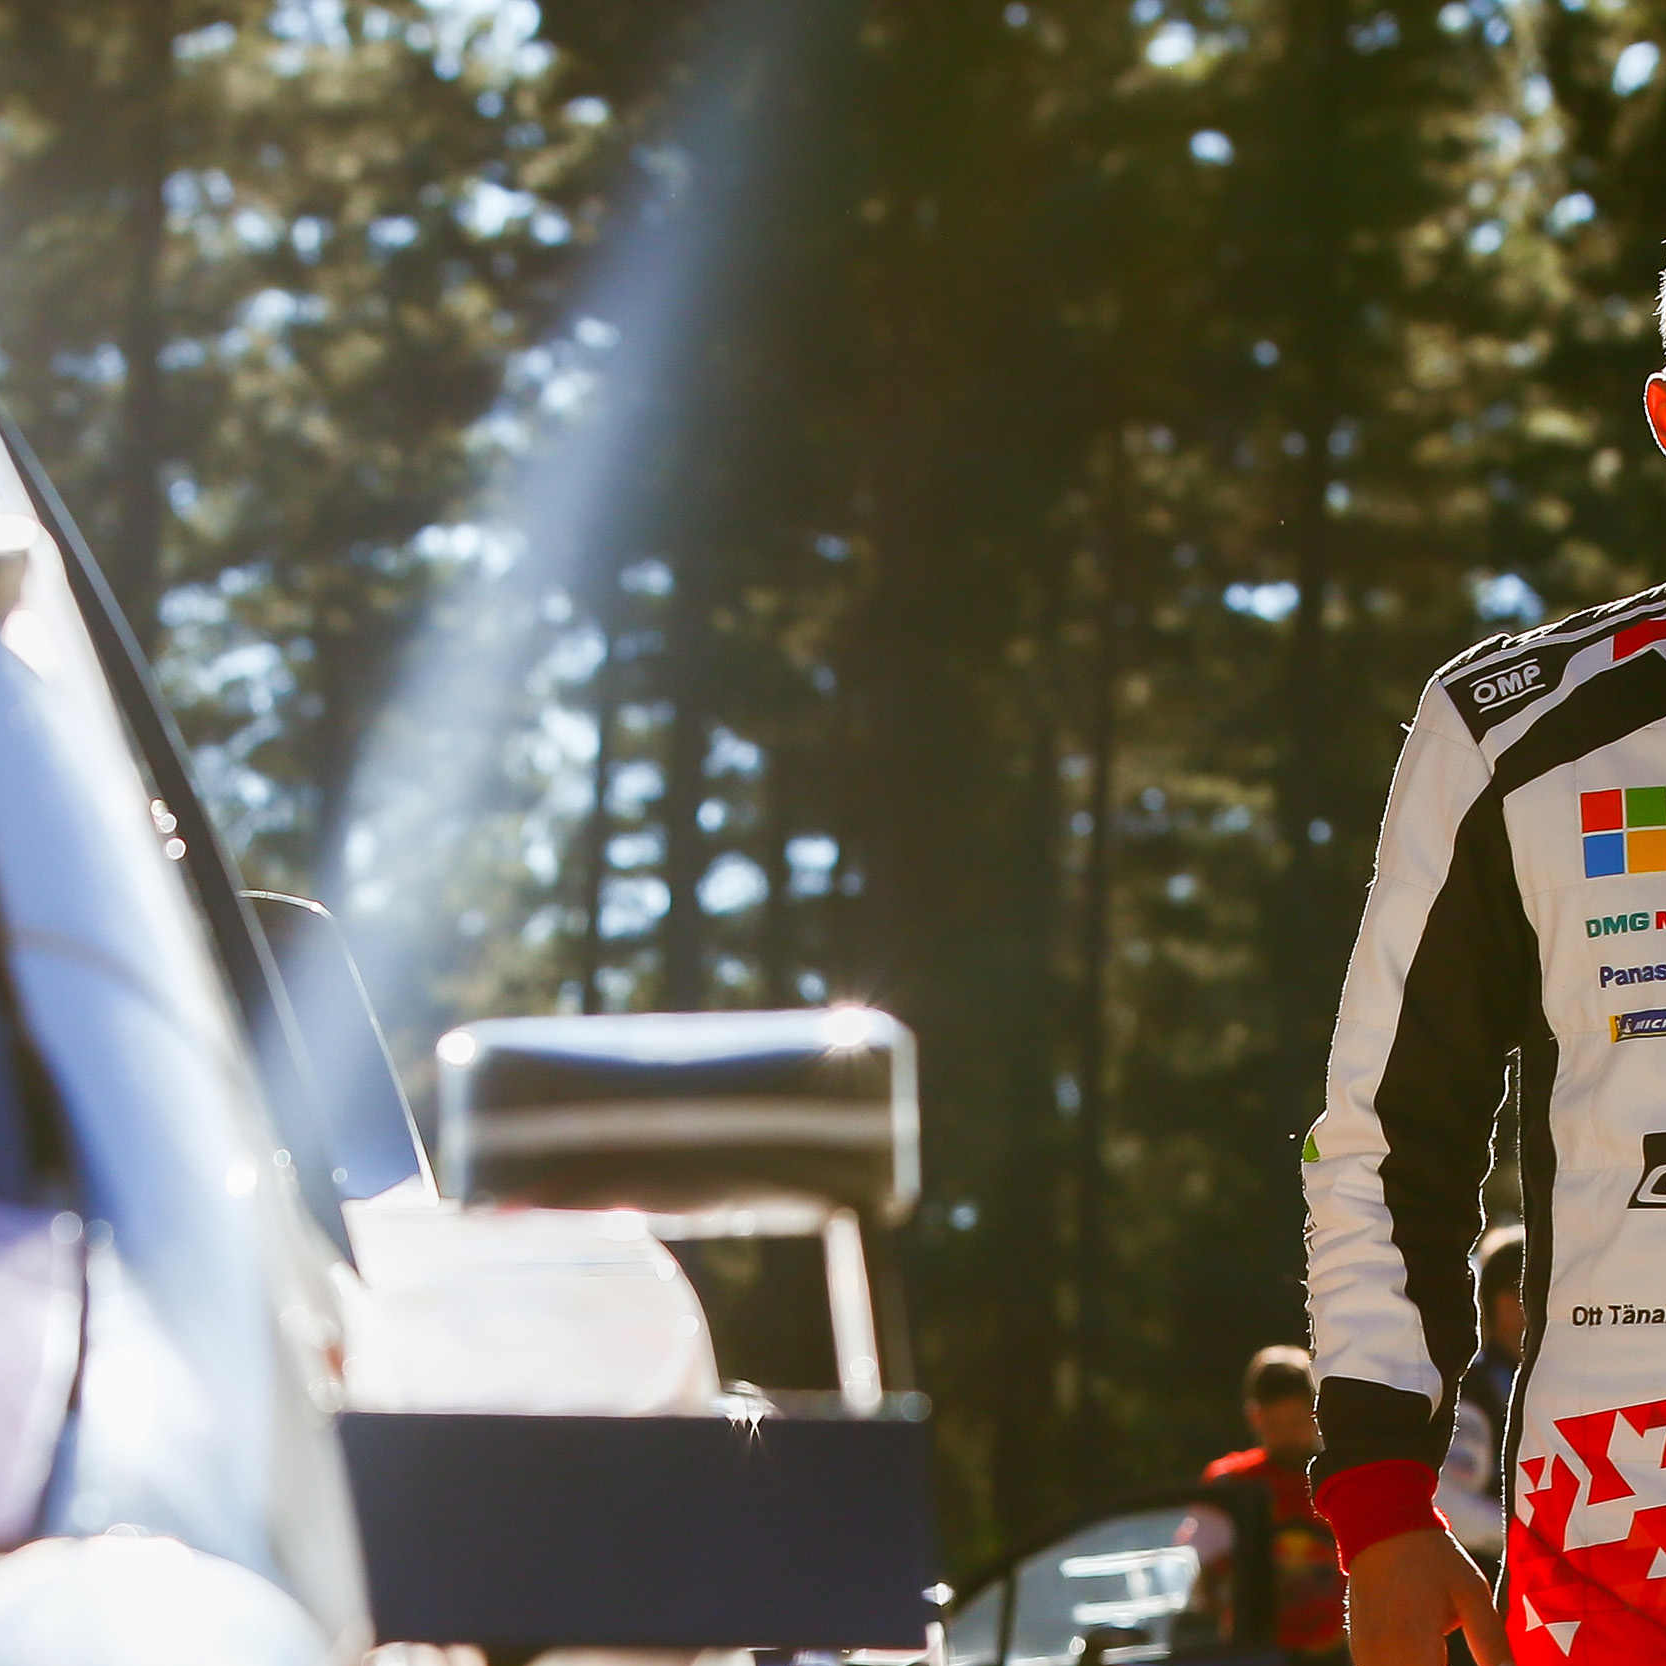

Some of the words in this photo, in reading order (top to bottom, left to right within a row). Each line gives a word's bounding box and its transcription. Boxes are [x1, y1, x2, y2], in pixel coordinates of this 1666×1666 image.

[1474, 664, 1541, 704] OMP
[1585, 911, 1650, 938] DMG
[1572, 1305, 1604, 1326] Ott
